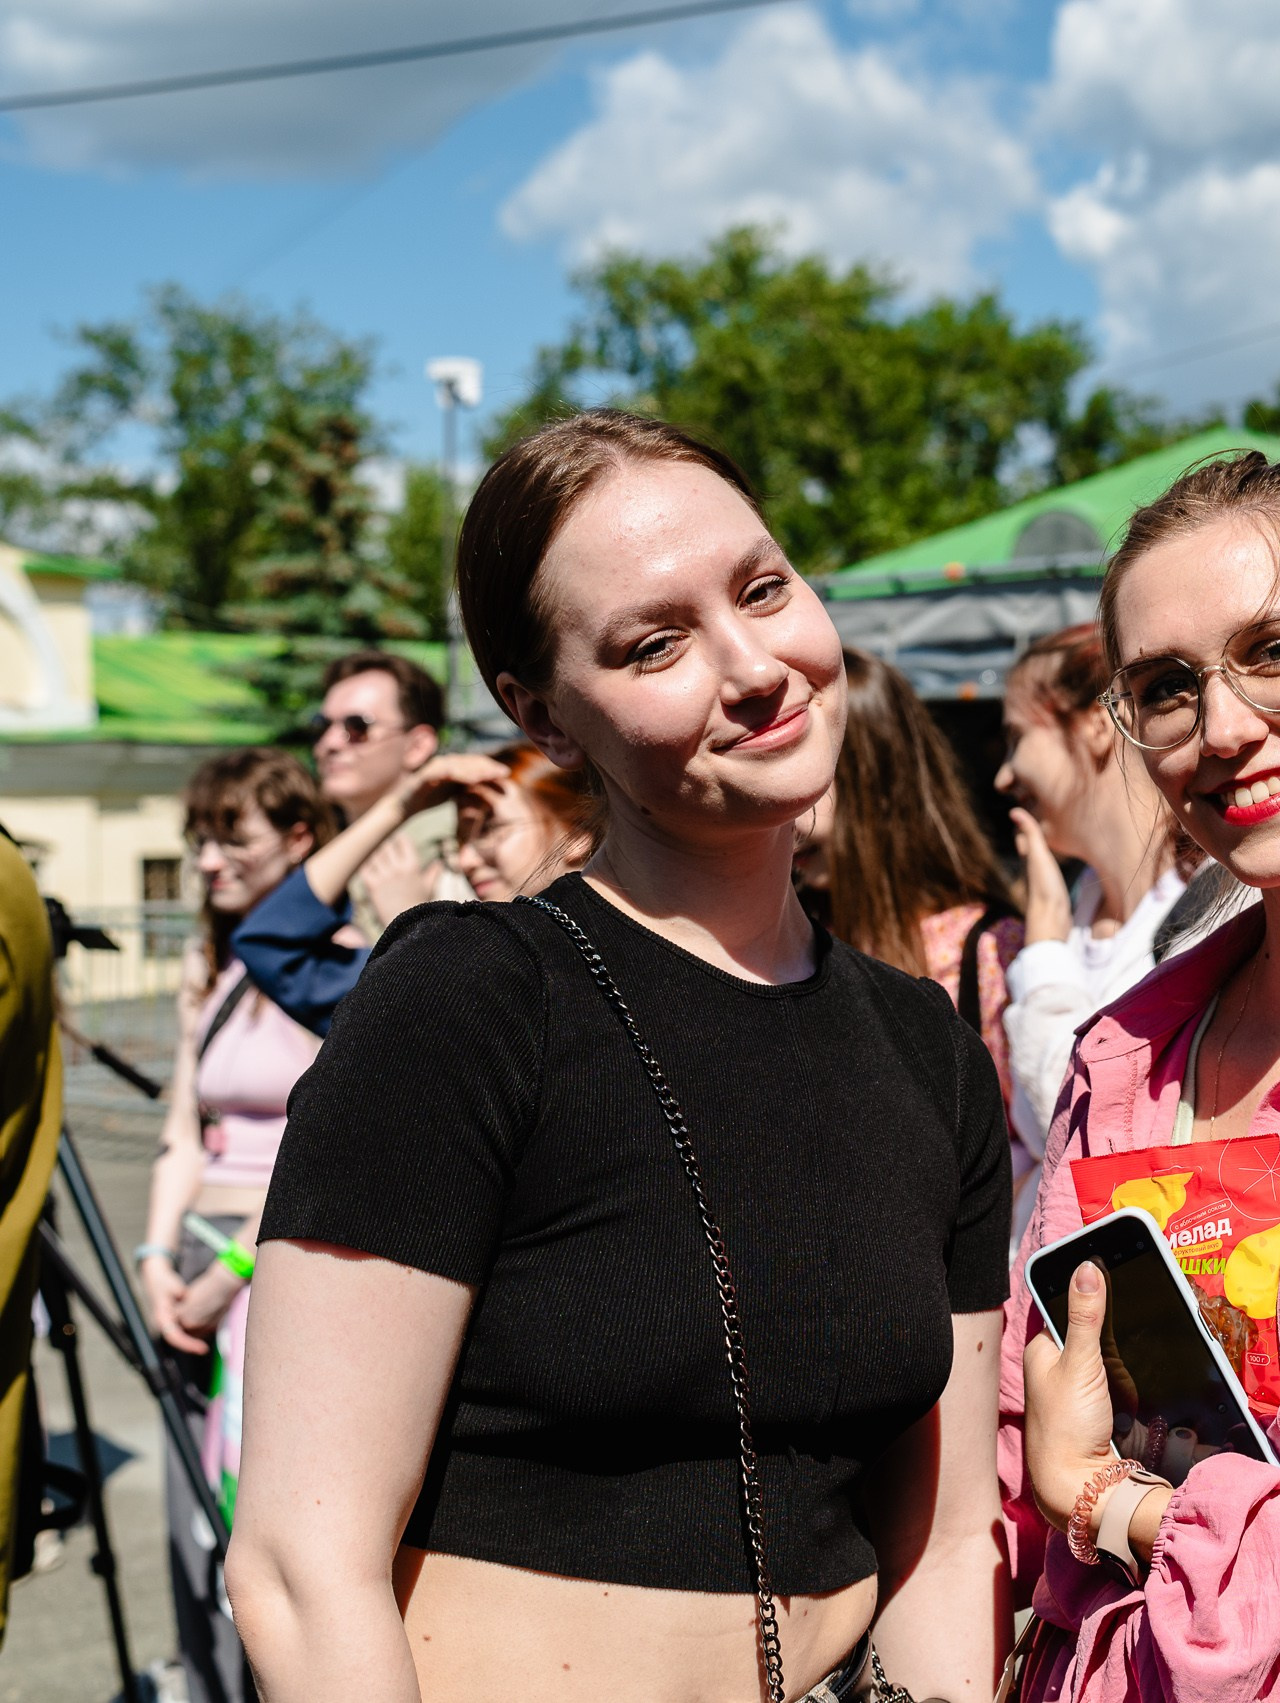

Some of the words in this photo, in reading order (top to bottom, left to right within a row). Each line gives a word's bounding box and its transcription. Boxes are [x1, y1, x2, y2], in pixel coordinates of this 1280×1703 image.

[1207, 1203, 1227, 1214] соком
[1168, 1218, 1233, 1249] мелад
[1207, 1242, 1220, 1250] вкус
[1249, 1355, 1261, 1363] 100
